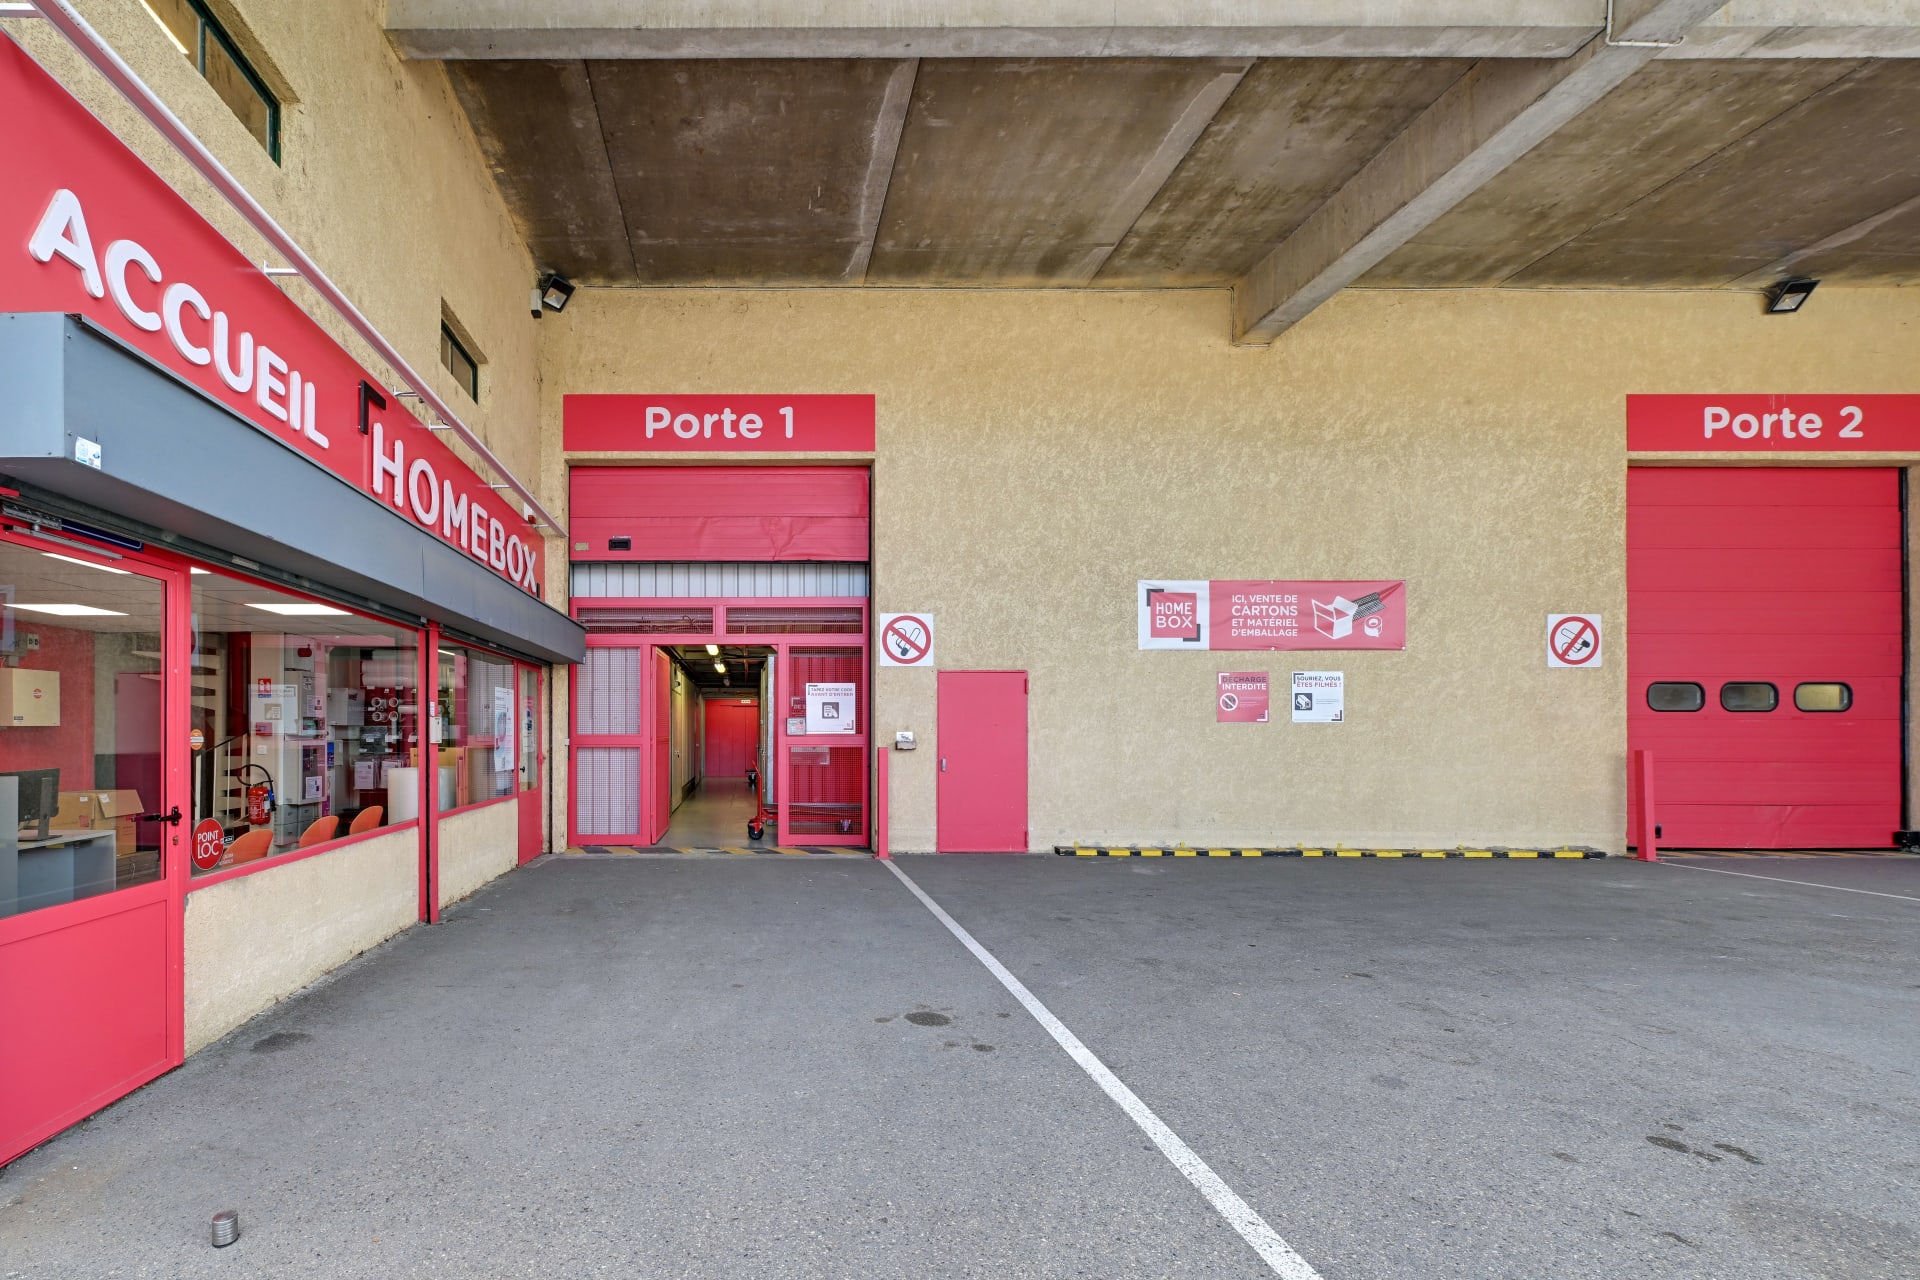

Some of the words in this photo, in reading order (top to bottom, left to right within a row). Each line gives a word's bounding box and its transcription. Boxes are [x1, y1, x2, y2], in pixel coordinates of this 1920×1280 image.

[28, 188, 330, 449] ACCUEIL
[645, 406, 763, 439] Porte
[779, 406, 794, 439] 1
[1703, 406, 1823, 439] Porte
[1838, 406, 1864, 439] 2
[372, 422, 537, 593] HOMEBOX
[1232, 595, 1247, 603] ICI,
[1249, 595, 1282, 603] VENTE
[1284, 595, 1298, 603] DE
[1156, 602, 1193, 615] HOME
[1232, 605, 1298, 616] CARTONS
[1156, 616, 1193, 629] BOX
[1232, 618, 1244, 627] ET
[1247, 617, 1298, 627] MATÉRIEL
[1231, 629, 1298, 637] D'EMBALLAGE
[197, 830, 219, 843] POINT
[197, 840, 219, 859] LOC
